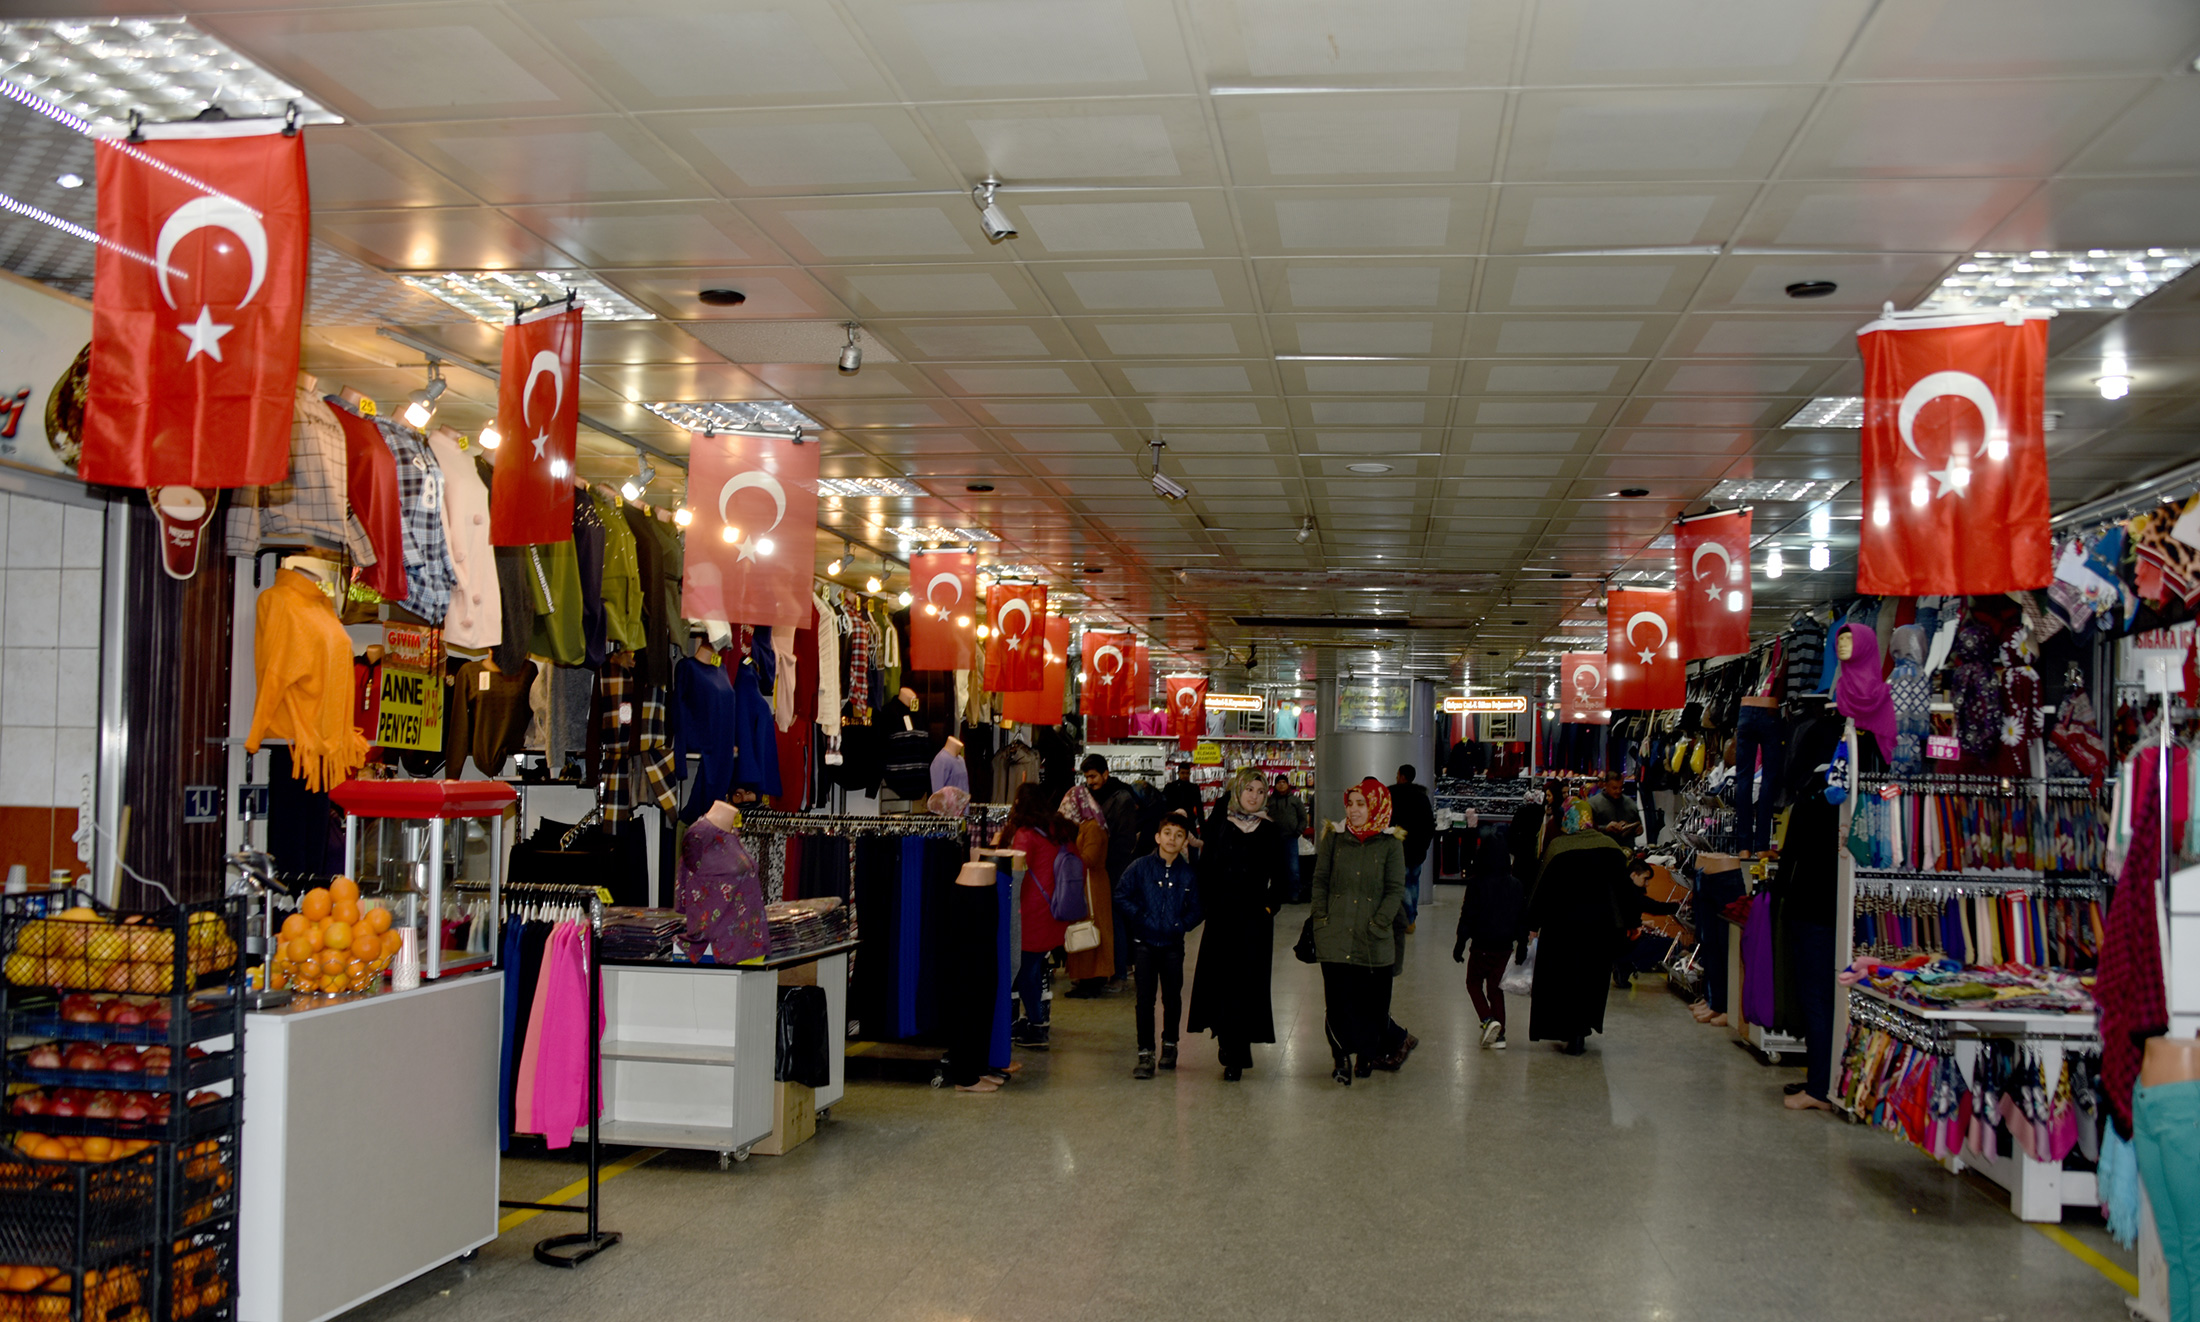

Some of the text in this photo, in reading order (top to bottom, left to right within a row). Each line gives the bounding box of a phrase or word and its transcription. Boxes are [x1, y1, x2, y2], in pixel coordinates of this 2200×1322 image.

[361, 400, 374, 412] 25
[381, 673, 423, 706] ANNE
[378, 709, 423, 746] PENYESİ
[1932, 745, 1944, 757] 10
